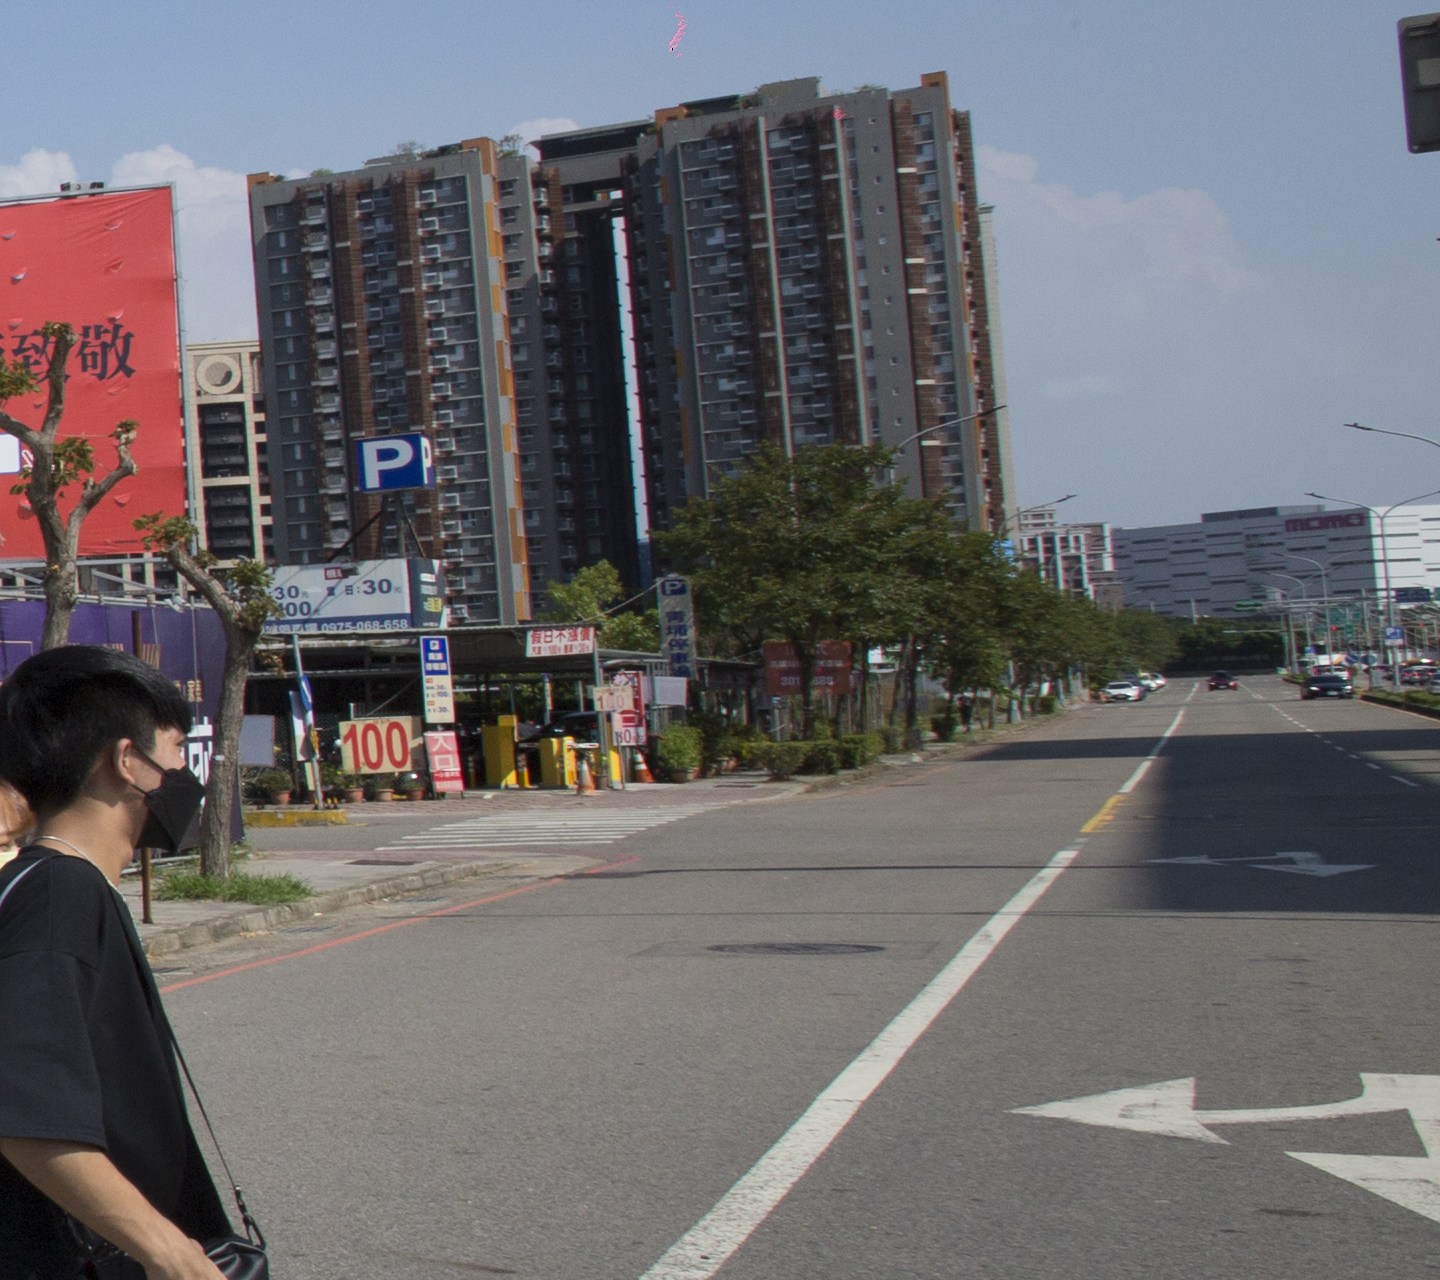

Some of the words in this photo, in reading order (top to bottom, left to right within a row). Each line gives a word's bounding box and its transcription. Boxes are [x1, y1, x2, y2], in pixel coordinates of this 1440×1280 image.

[362, 438, 415, 489] P
[342, 720, 409, 771] 100
[431, 735, 456, 771] 入口
